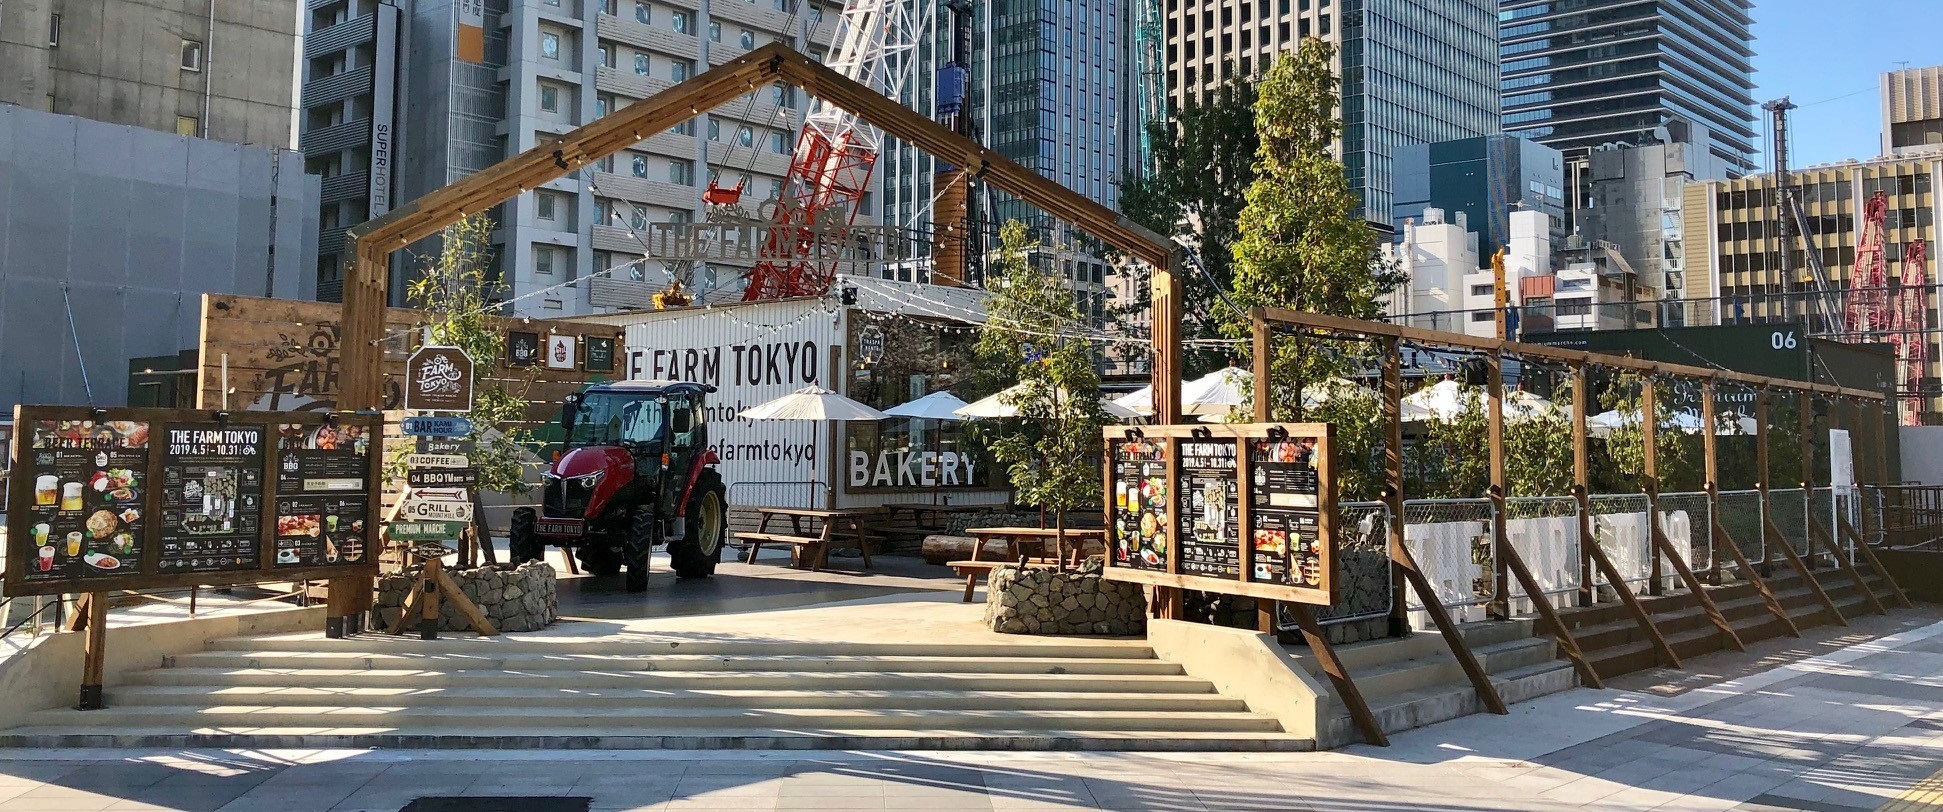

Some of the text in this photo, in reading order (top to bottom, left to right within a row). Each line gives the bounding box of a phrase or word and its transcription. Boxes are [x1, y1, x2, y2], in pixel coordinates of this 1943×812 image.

[656, 224, 707, 260] THE
[720, 225, 798, 260] FARM
[1771, 331, 1797, 350] 06
[654, 346, 721, 387] FARM
[732, 340, 817, 386] TOKYO
[421, 363, 461, 380] FARM
[265, 357, 339, 411] FAR
[416, 376, 447, 392] TOKYO
[405, 420, 432, 433] 01 BAR
[170, 430, 258, 444] THE FARM TOKYO
[170, 444, 206, 455] 2019.4.5
[217, 444, 238, 455] 10.31
[428, 443, 460, 452] Bakery
[1181, 443, 1237, 456] THE FARM TOKYO
[283, 462, 298, 470] BBQ
[410, 456, 419, 464] 03
[420, 456, 450, 465] COFFEE
[851, 451, 976, 486] BAKERY
[411, 474, 420, 483] 04
[423, 473, 443, 483] BBQ
[417, 503, 451, 516] GRILL
[395, 523, 446, 535] PREMIUM MARCHE
[536, 524, 546, 532] THE
[564, 525, 581, 533] TOKYO
